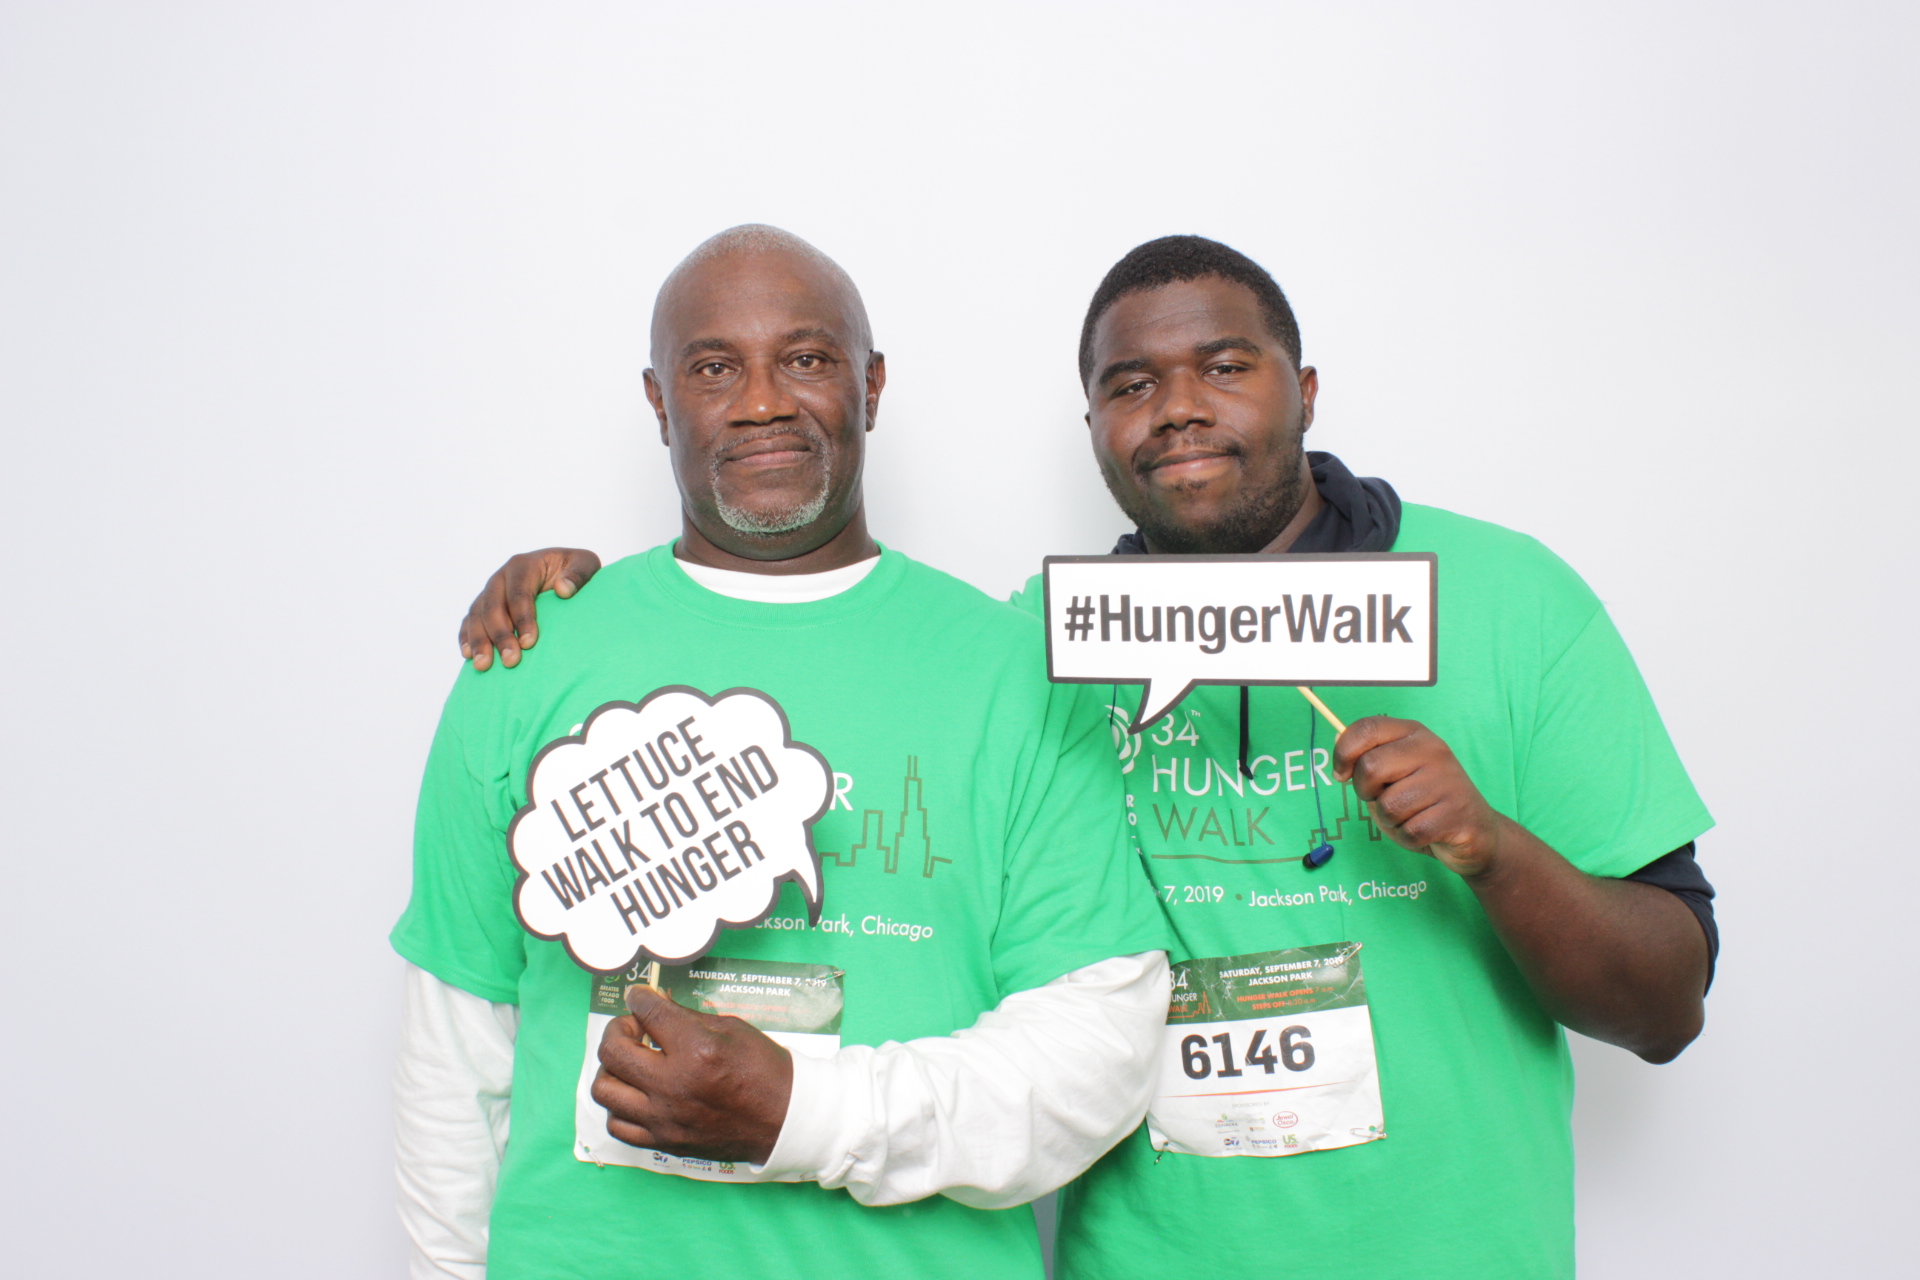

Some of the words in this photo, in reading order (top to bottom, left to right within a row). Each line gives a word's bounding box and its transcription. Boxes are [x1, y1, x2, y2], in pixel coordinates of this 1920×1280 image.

[1064, 593, 1413, 655] #HungerWalk
[1151, 711, 1200, 747] 34
[550, 715, 716, 843] LETTUCE
[1151, 748, 1332, 798] HUNGER
[540, 819, 652, 911] WALK
[639, 791, 700, 850] TO
[692, 745, 779, 822] END
[1152, 802, 1275, 846] WALK
[610, 820, 766, 936] HUNGER
[1164, 885, 1178, 906] 7,
[1184, 885, 1224, 903] 2019
[1248, 890, 1314, 907] Jackson
[1358, 880, 1427, 901] Chicago
[754, 915, 805, 931] kson
[861, 915, 933, 942] Chicago
[626, 961, 652, 983] 34
[688, 969, 738, 983] SATURDAY,
[741, 973, 792, 986] SEPTEMBER
[1219, 966, 1263, 979] SATURDAY,
[1264, 960, 1312, 974] SEPTEMBER
[1313, 958, 1322, 968] 7,
[1248, 974, 1289, 987] JACKSON
[1289, 971, 1314, 982] PARK
[719, 983, 764, 995] JACKSON
[766, 987, 791, 997] PARK
[1171, 992, 1198, 1003] UNGER
[1236, 993, 1267, 1003] HUNGER
[1267, 990, 1289, 1000] WALK
[1289, 988, 1314, 997] OPENS
[1251, 1001, 1272, 1011] STEPS
[1272, 1000, 1288, 1008] OFF
[1181, 1025, 1316, 1081] 6146
